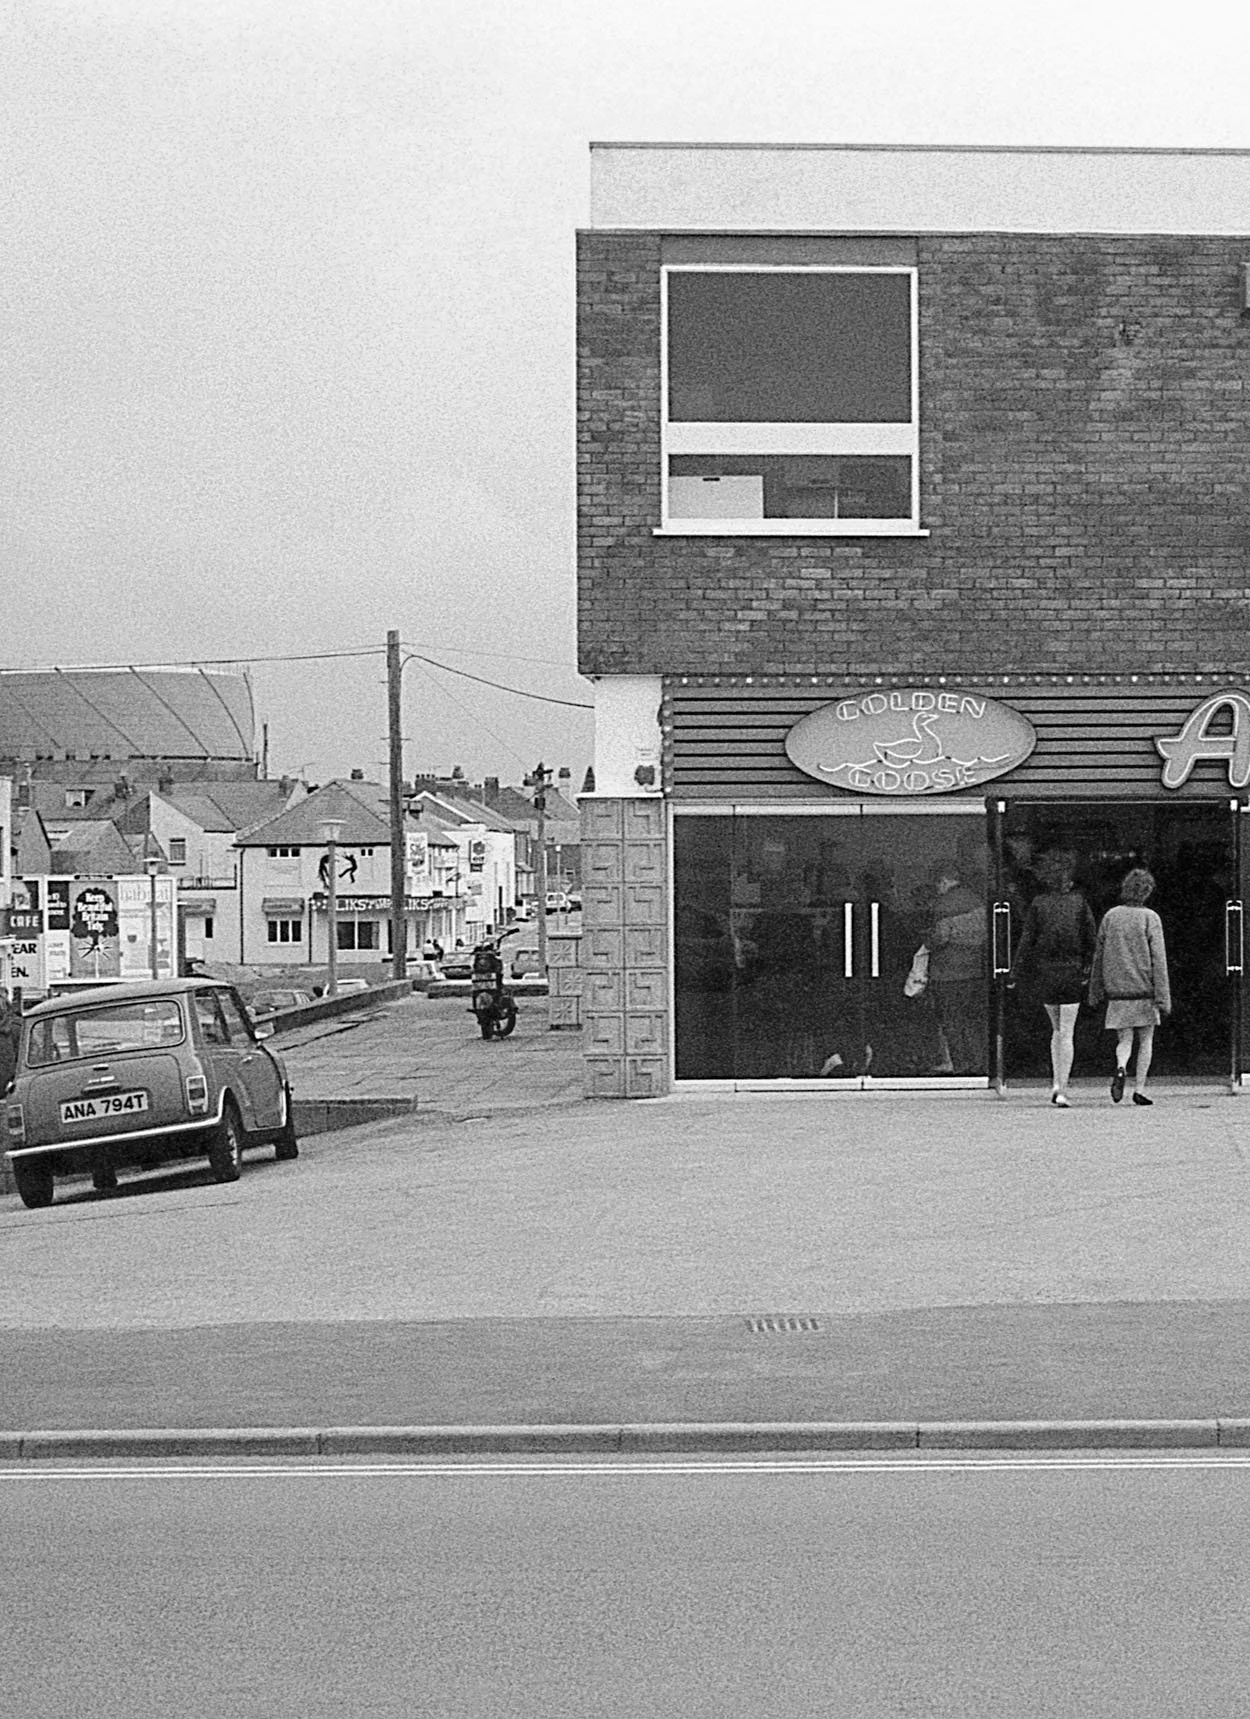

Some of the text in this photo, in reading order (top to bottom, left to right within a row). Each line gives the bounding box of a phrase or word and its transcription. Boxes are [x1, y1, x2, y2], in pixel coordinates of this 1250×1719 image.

[836, 692, 986, 721] GOLDEN
[847, 767, 977, 791] GOOSE
[10, 915, 40, 928] CAFE
[64, 1094, 144, 1121] ANA 794T
